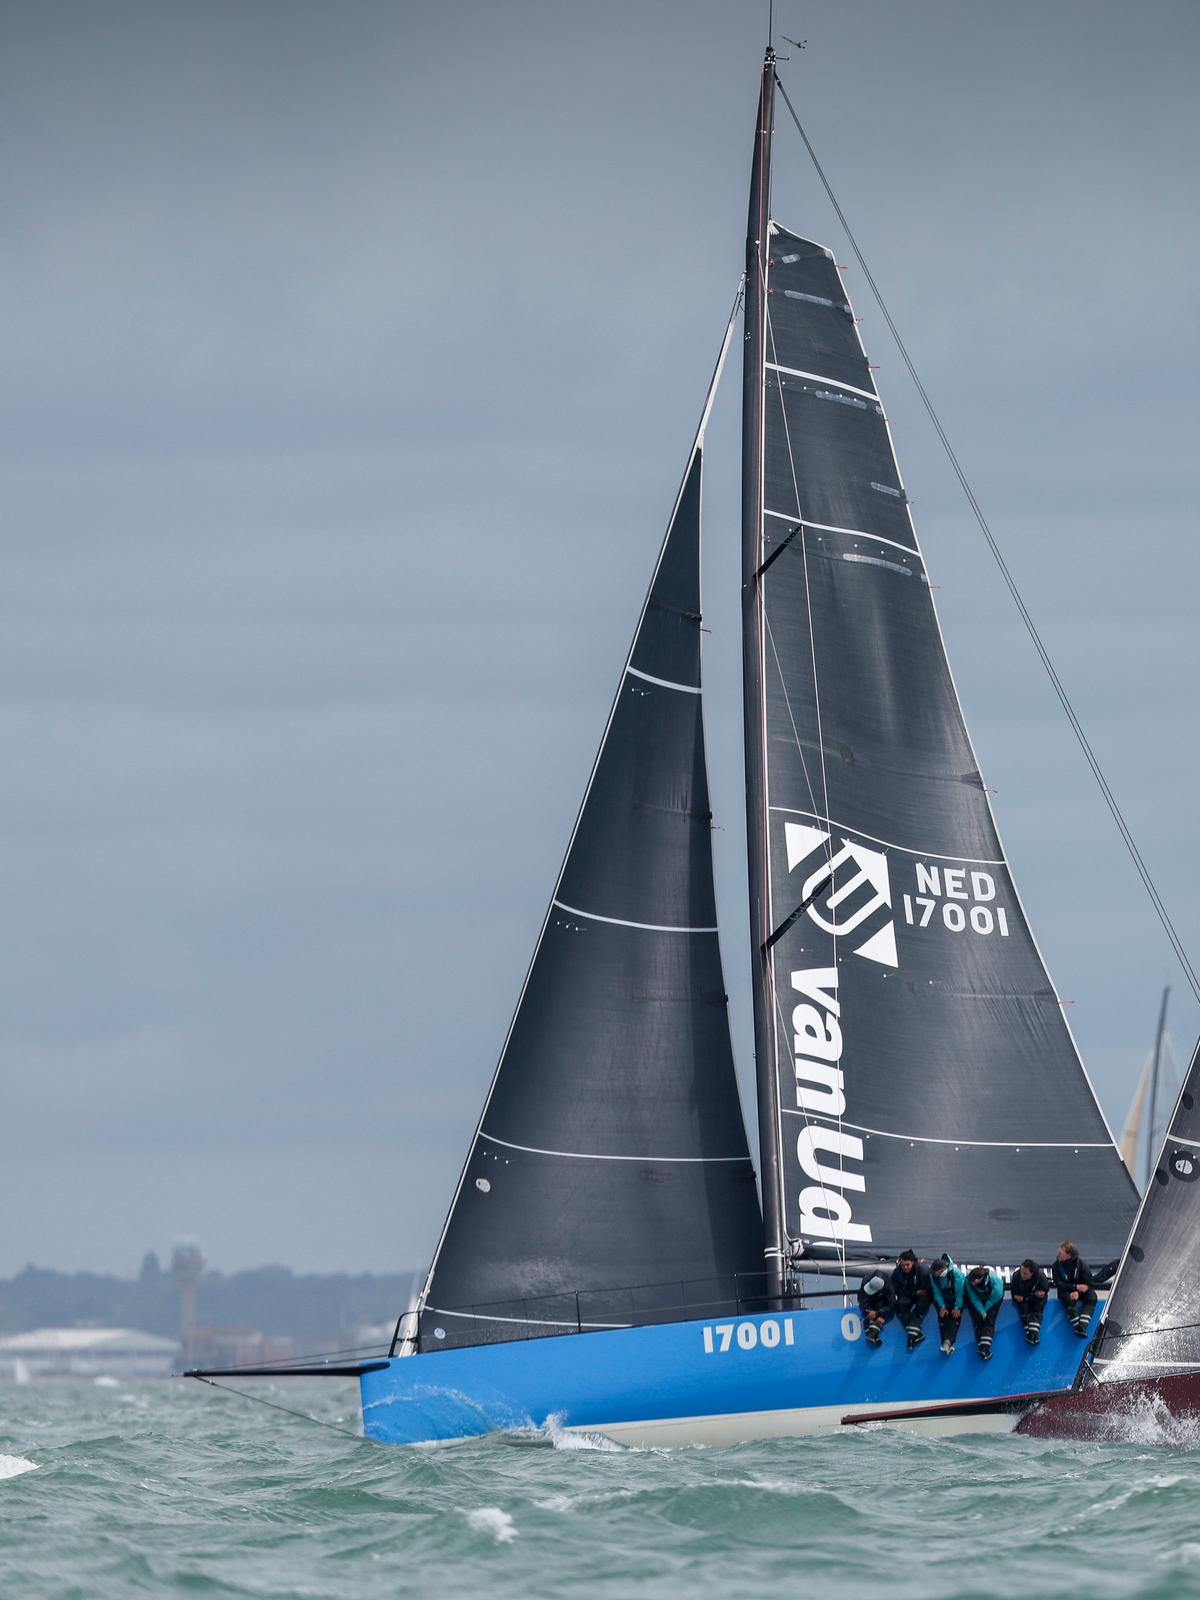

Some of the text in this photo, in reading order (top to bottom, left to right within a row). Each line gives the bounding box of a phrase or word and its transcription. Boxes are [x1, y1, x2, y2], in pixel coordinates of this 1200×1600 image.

[915, 863, 996, 902] NED
[903, 894, 1009, 936] 17001
[791, 968, 872, 1248] van Ud
[703, 1318, 794, 1353] 17001
